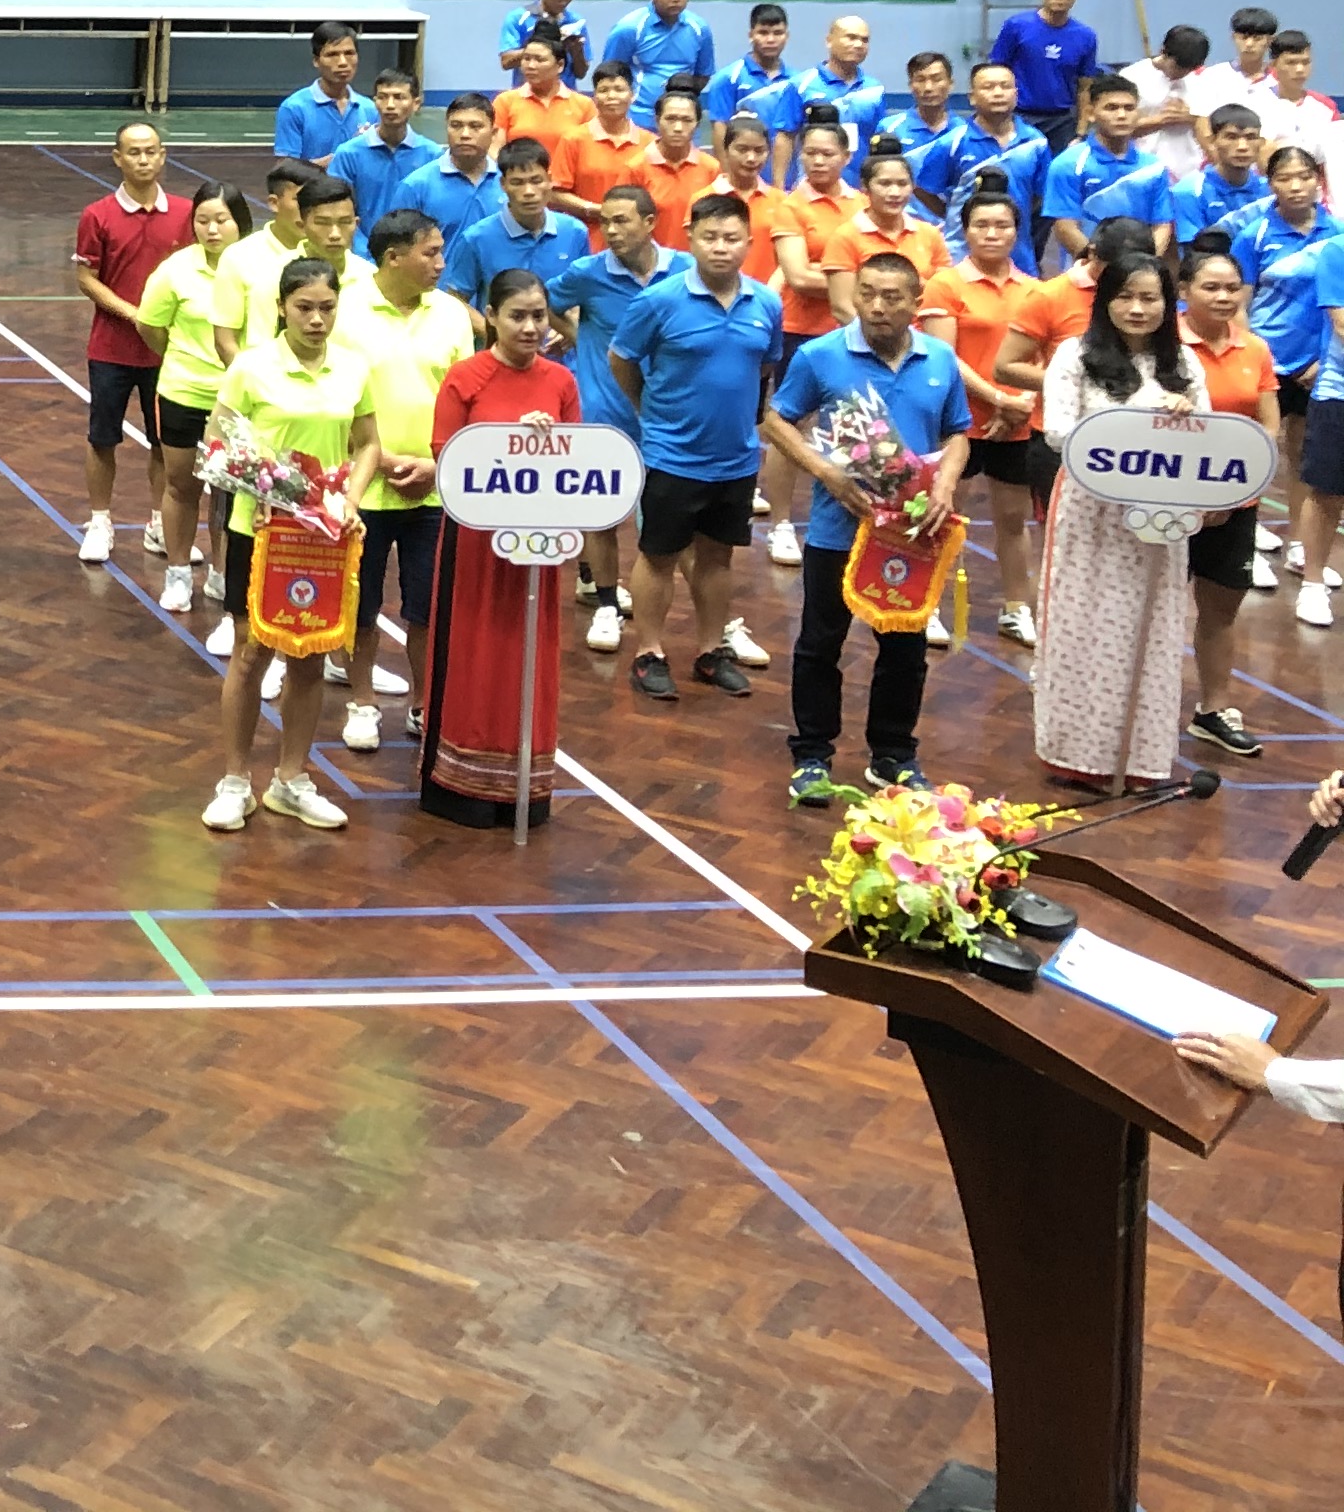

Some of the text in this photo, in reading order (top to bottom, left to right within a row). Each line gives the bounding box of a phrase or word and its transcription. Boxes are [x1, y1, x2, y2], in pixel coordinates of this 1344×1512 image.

[463, 458, 621, 495] LÀO CAI
[1086, 447, 1247, 483] SƠN LA
